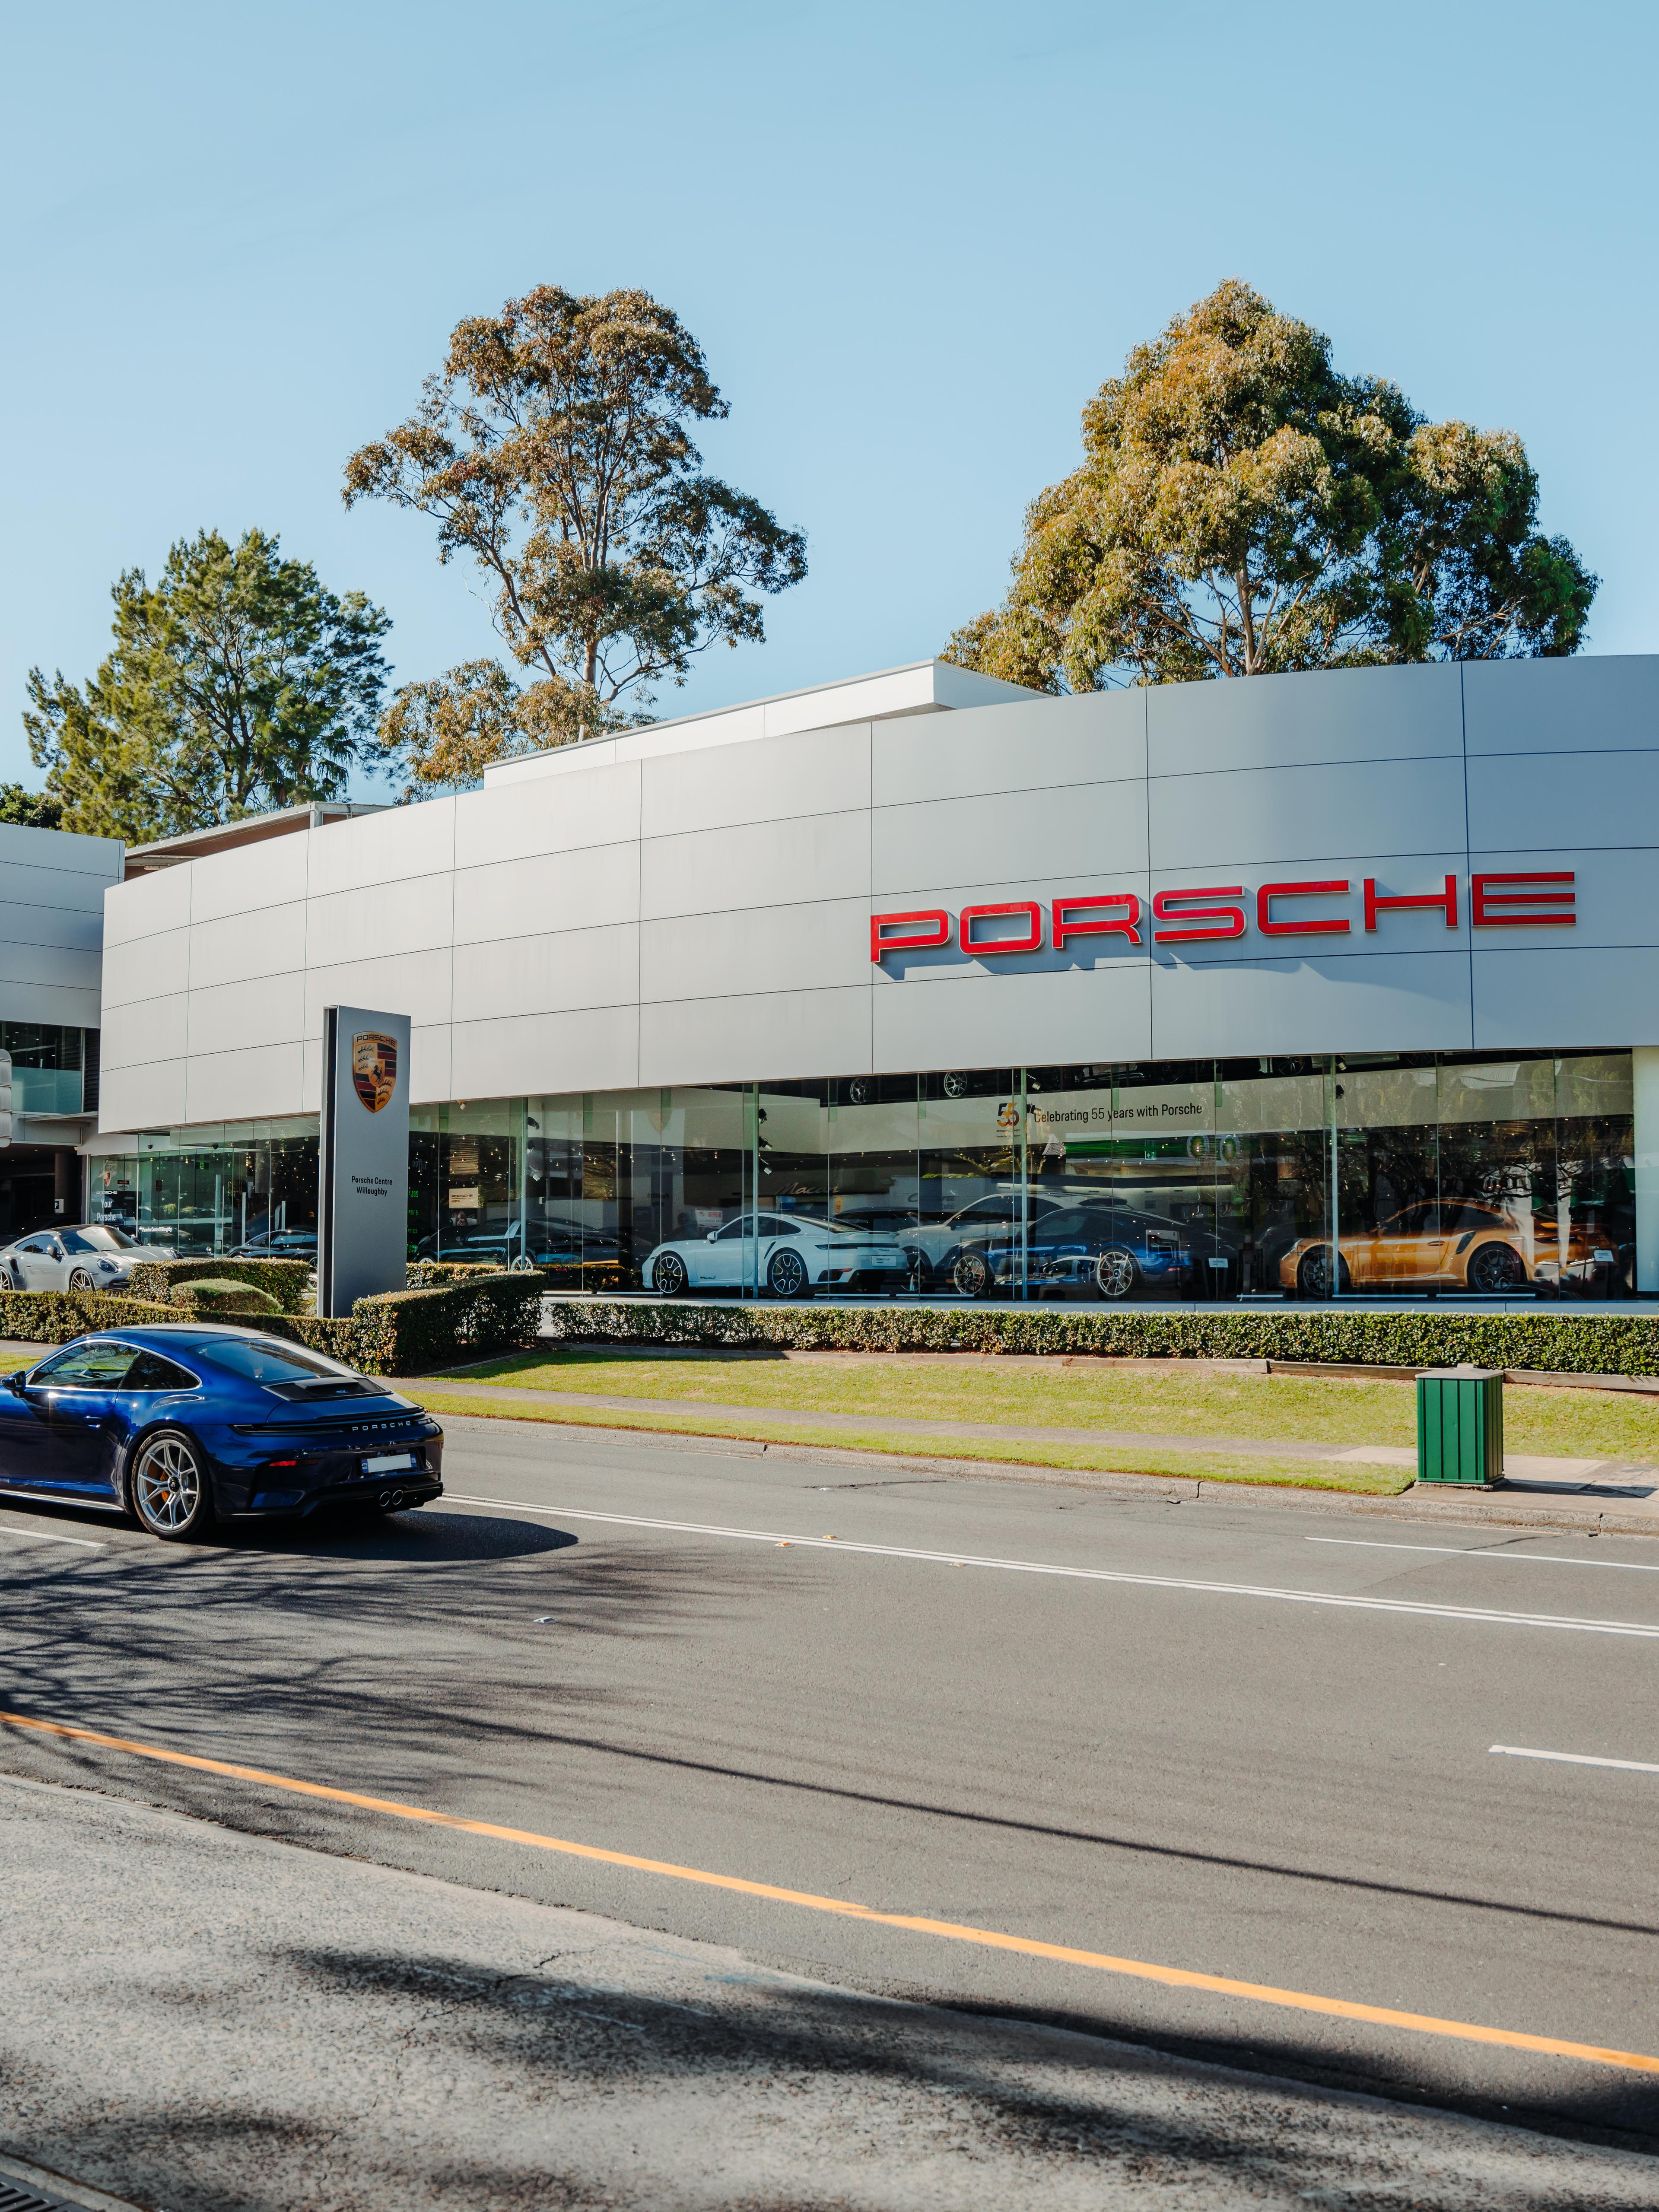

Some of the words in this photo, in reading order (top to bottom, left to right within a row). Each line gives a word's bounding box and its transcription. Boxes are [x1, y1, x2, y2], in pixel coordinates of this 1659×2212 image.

[870, 871, 1576, 963] PORSCHE
[356, 1034, 396, 1048] PORSCHE
[1091, 1108, 1105, 1120] 55
[1107, 1108, 1134, 1122] years
[1137, 1105, 1158, 1117] with
[1162, 1103, 1202, 1116] Porsche
[351, 1176, 374, 1184] Porsche
[375, 1177, 393, 1185] Centre
[356, 1186, 388, 1197] Willoughby
[100, 1199, 112, 1208] Your
[97, 1212, 116, 1221] Porsche
[352, 1421, 411, 1431] PORSCHE
